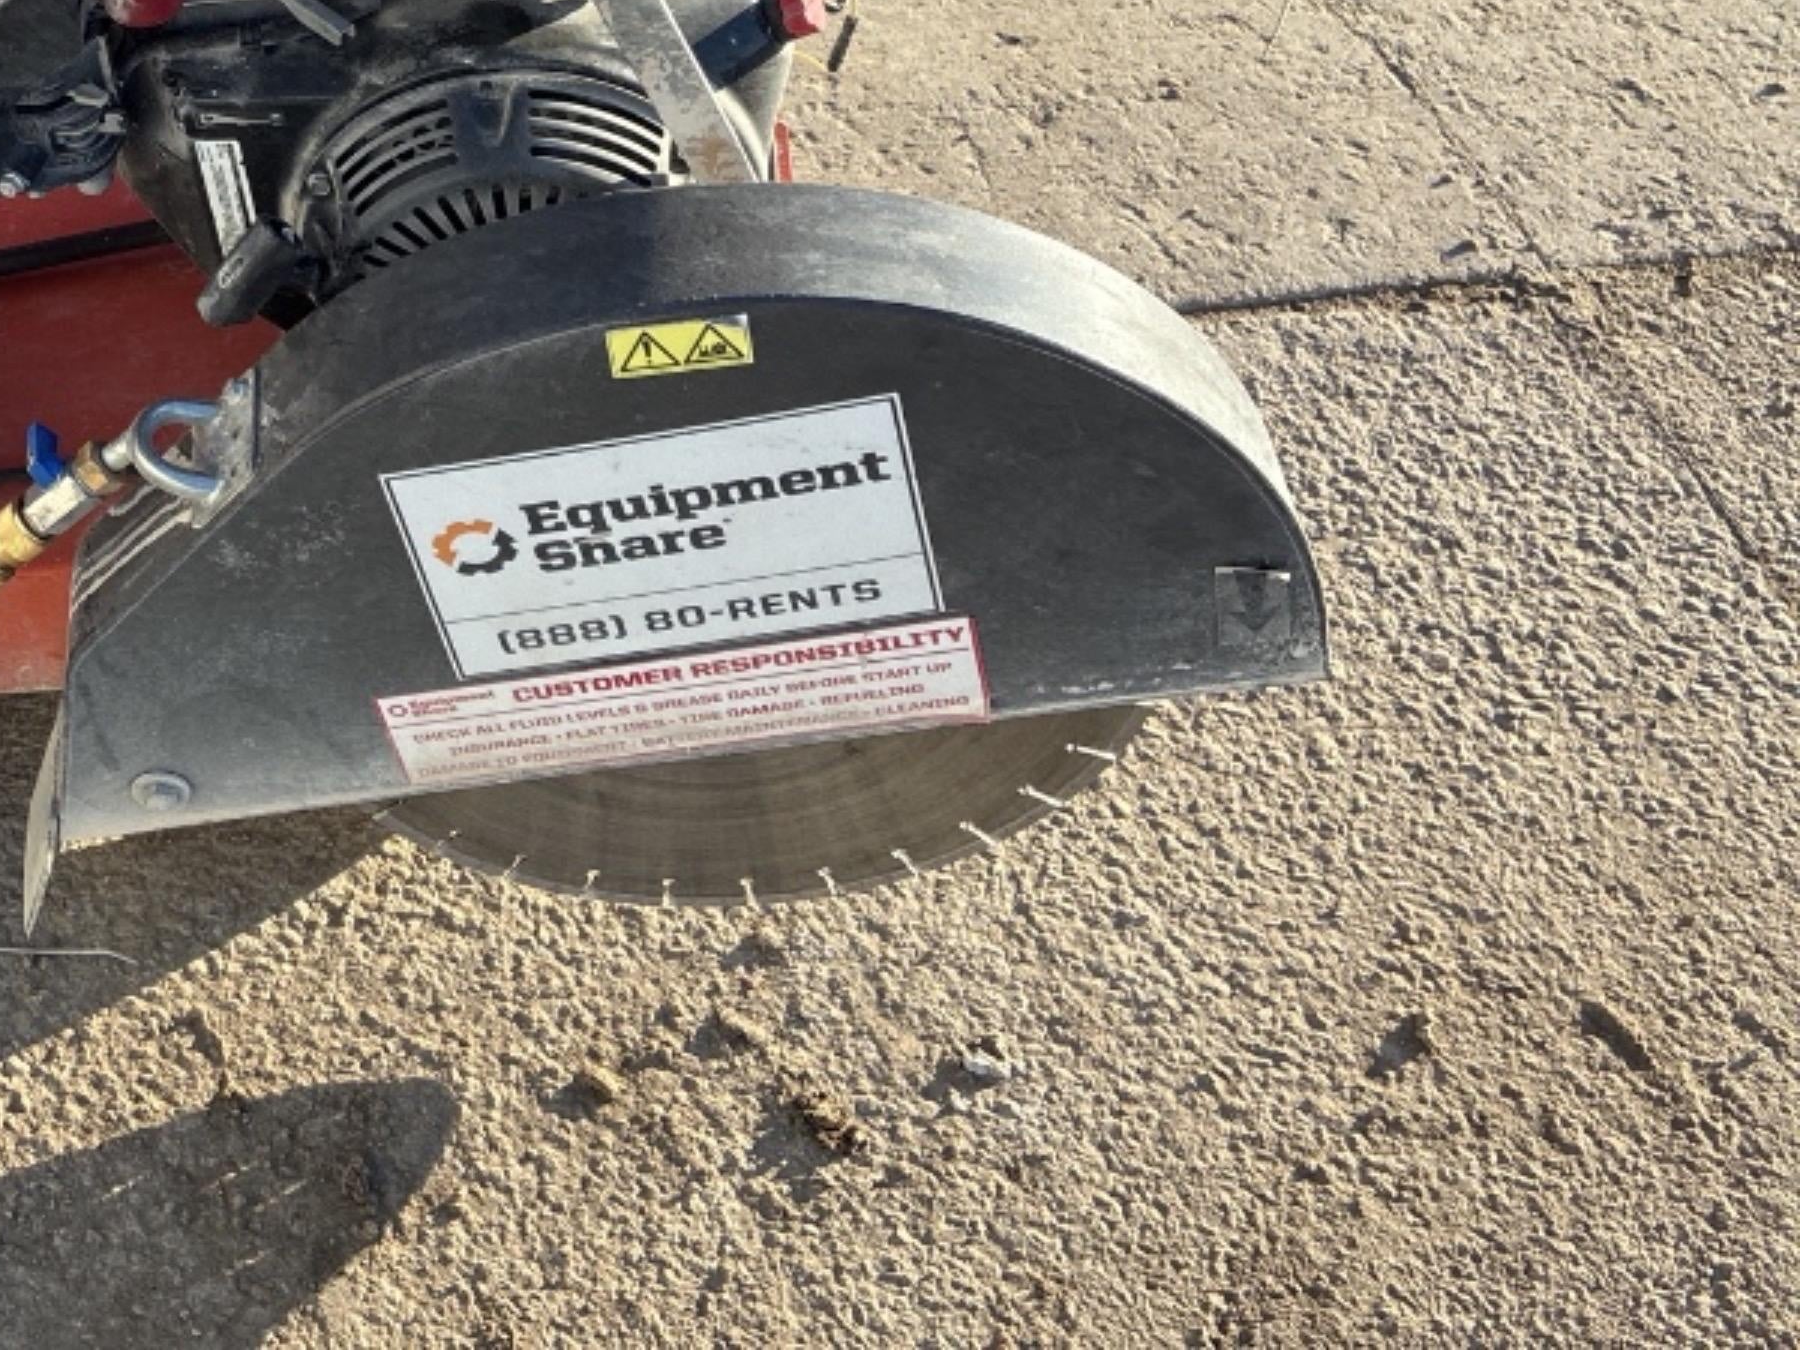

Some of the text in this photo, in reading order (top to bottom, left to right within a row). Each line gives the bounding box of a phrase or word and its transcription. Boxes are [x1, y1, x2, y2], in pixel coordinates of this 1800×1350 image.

[519, 451, 892, 536] Equipment
[496, 578, 883, 655] (888) 80-RENTS
[511, 625, 965, 702] CUSTOMER RESPONSIBILITY
